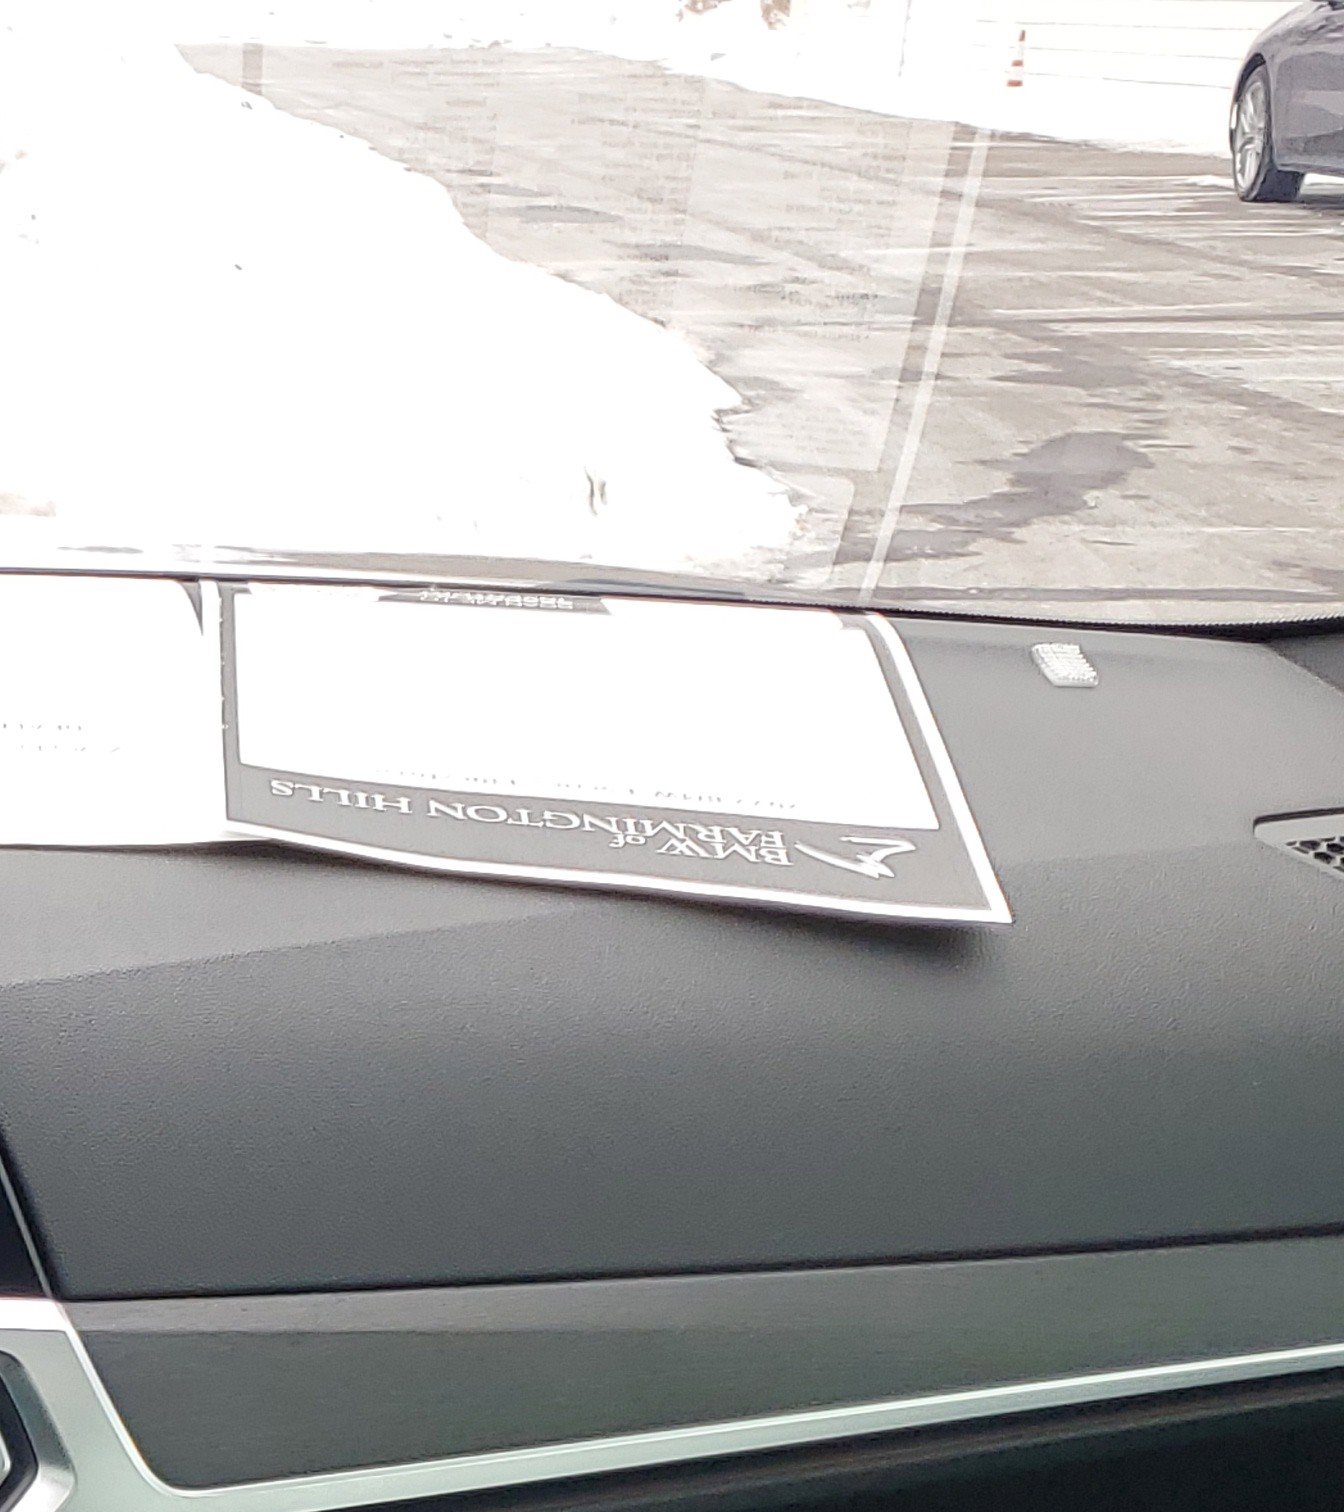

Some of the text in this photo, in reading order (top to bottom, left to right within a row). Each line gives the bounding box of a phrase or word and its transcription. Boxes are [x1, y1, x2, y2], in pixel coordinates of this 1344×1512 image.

[271, 778, 410, 815] HILLS
[428, 803, 786, 849] FARMINGTON
[610, 830, 794, 867] BMW of
